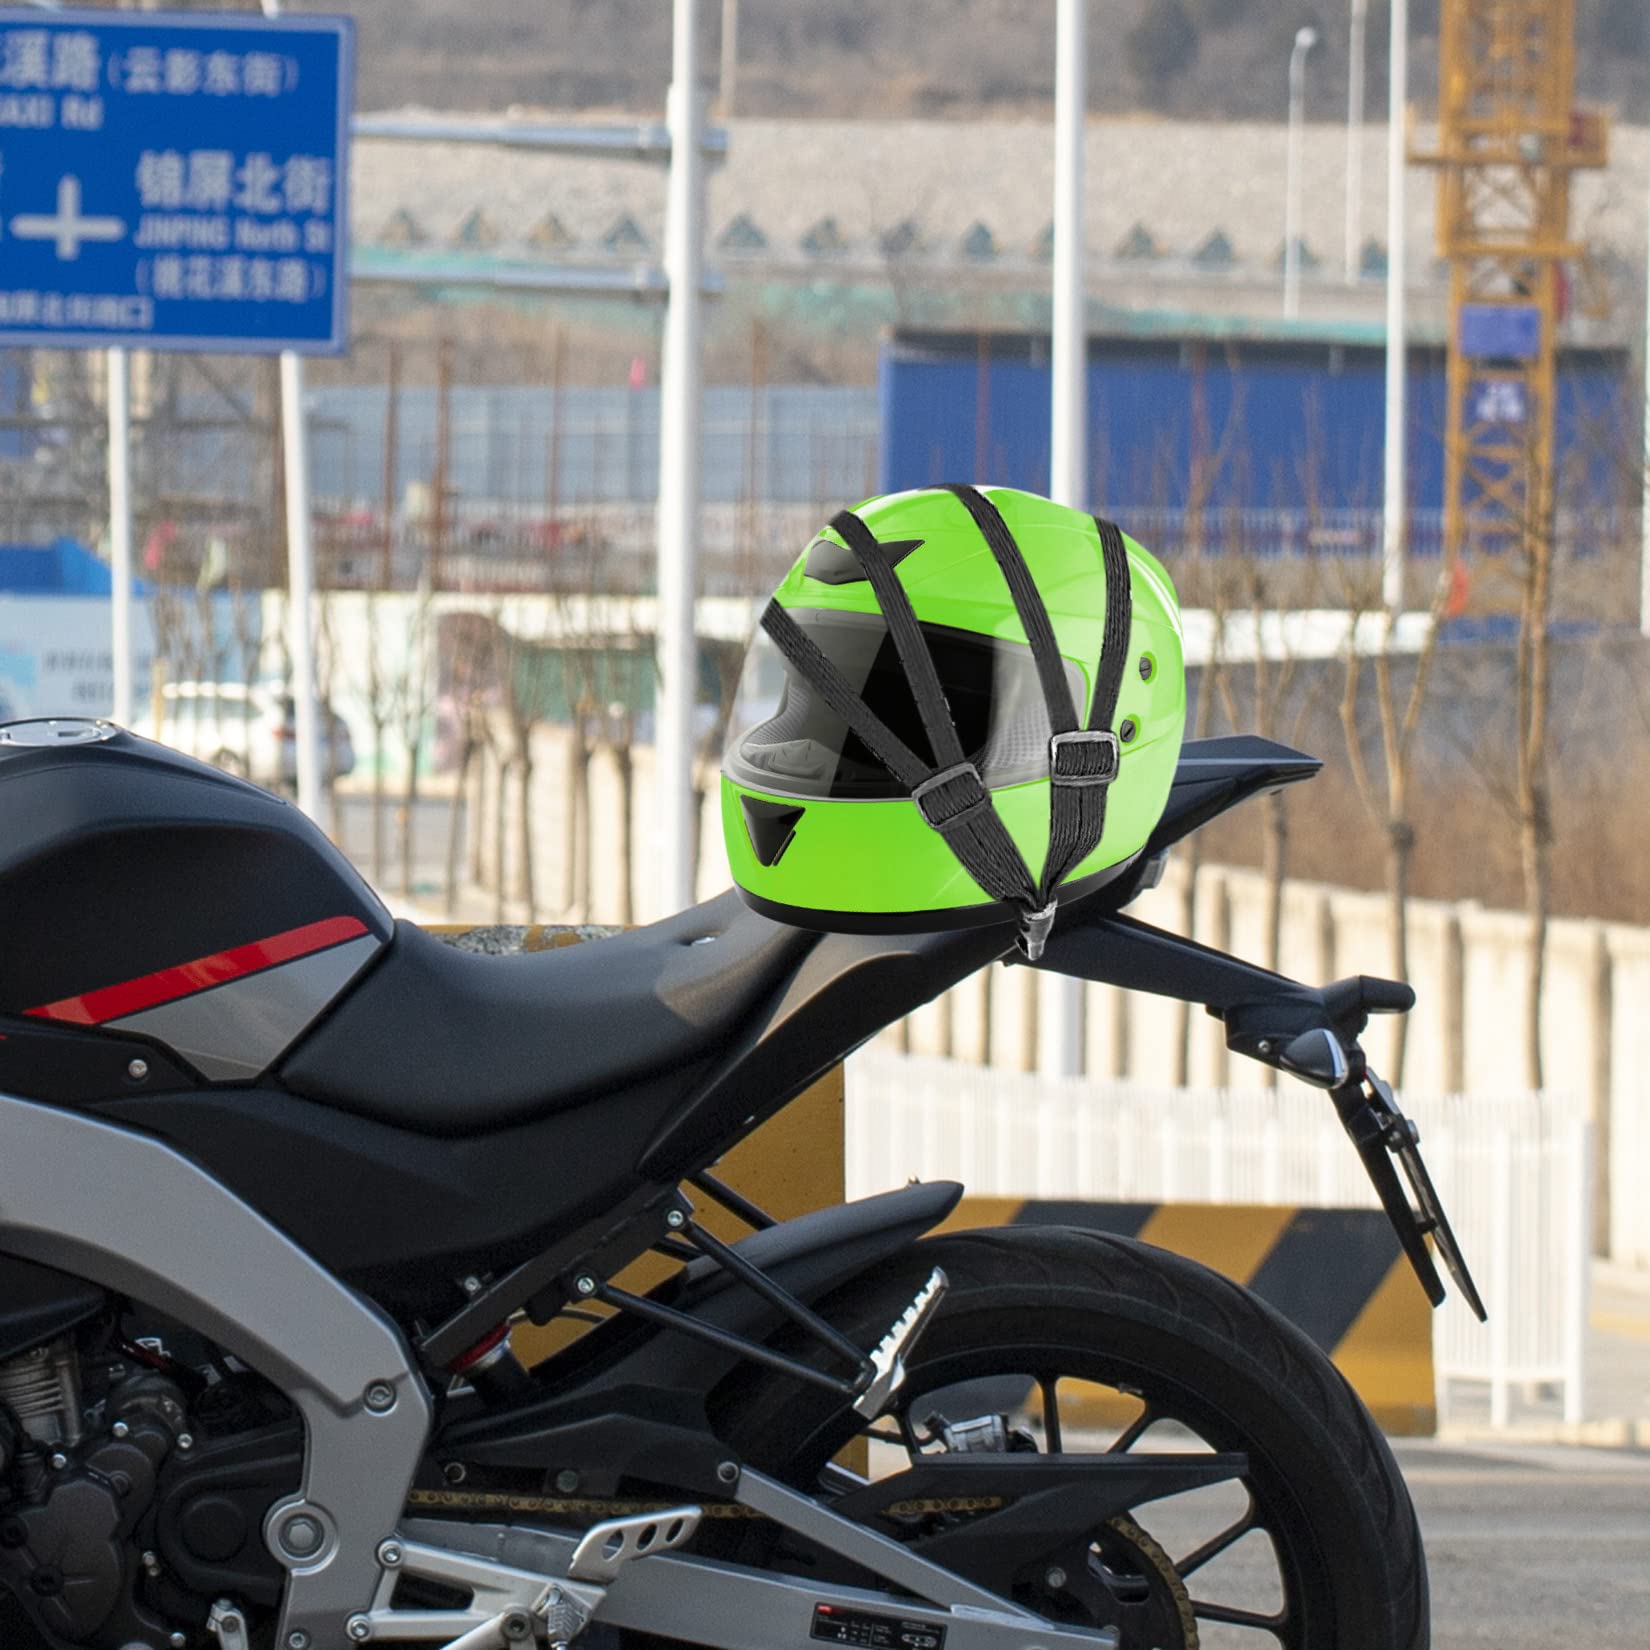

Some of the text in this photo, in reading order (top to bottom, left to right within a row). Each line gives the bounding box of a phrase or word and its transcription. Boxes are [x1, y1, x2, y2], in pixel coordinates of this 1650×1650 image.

[0, 30, 99, 91] 溪路
[0, 95, 104, 130] AXI Rd
[135, 149, 331, 214] 锦屏北街
[133, 213, 332, 252] JINPING North St
